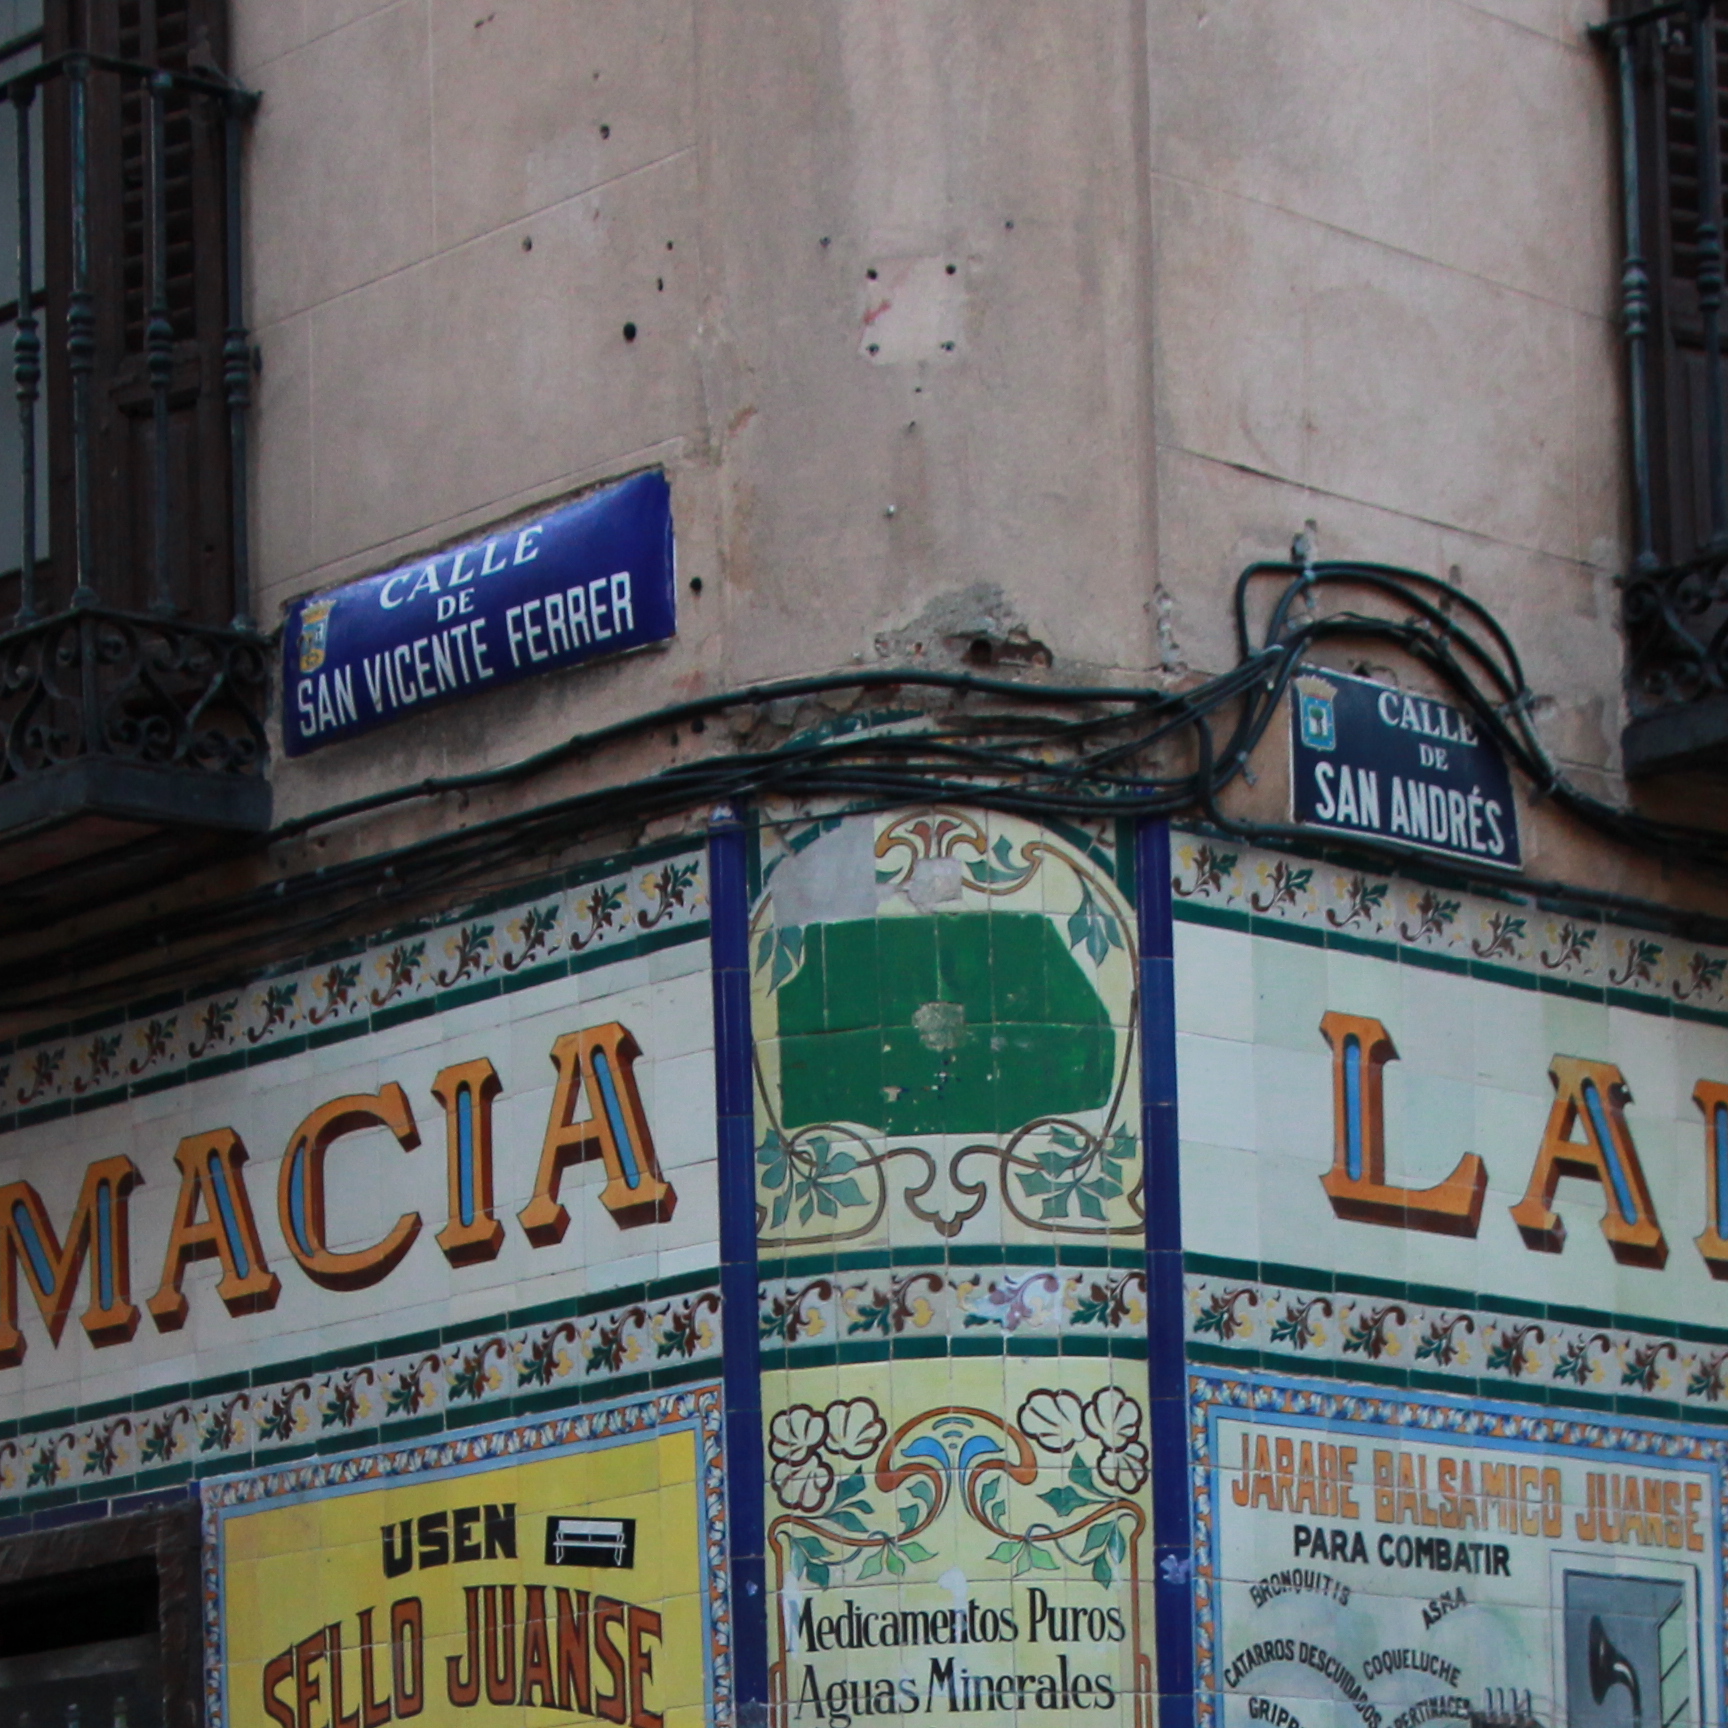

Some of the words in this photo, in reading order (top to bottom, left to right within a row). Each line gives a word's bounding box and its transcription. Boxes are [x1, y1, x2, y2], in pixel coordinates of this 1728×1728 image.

[379, 525, 543, 611] CALLE
[435, 588, 476, 622] DE
[297, 664, 359, 739] SAN
[363, 618, 494, 714] VICENTE
[505, 571, 635, 669] FERRER
[1377, 690, 1480, 748] CALLE
[1418, 742, 1449, 772] DE
[1314, 761, 1381, 829] SAN
[1390, 775, 1506, 857] ANDRÉS
[1232, 1432, 1360, 1520] JARABE
[1373, 1450, 1564, 1539] BALSAMICO
[1575, 1471, 1705, 1554] JUANSE
[381, 1502, 518, 1580] USEN
[1293, 1524, 1370, 1565] PARA
[1377, 1532, 1513, 1578] COMBATIR
[1250, 1567, 1352, 1609] BRONQUITIS
[1421, 1584, 1469, 1632] ASMA
[789, 1597, 1019, 1653] Medicamentos
[1026, 1586, 1127, 1645] Puros
[924, 1654, 1116, 1713] Minerales
[1224, 1639, 1296, 1690] CATARROS
[1363, 1648, 1464, 1689] COQUELUCHE
